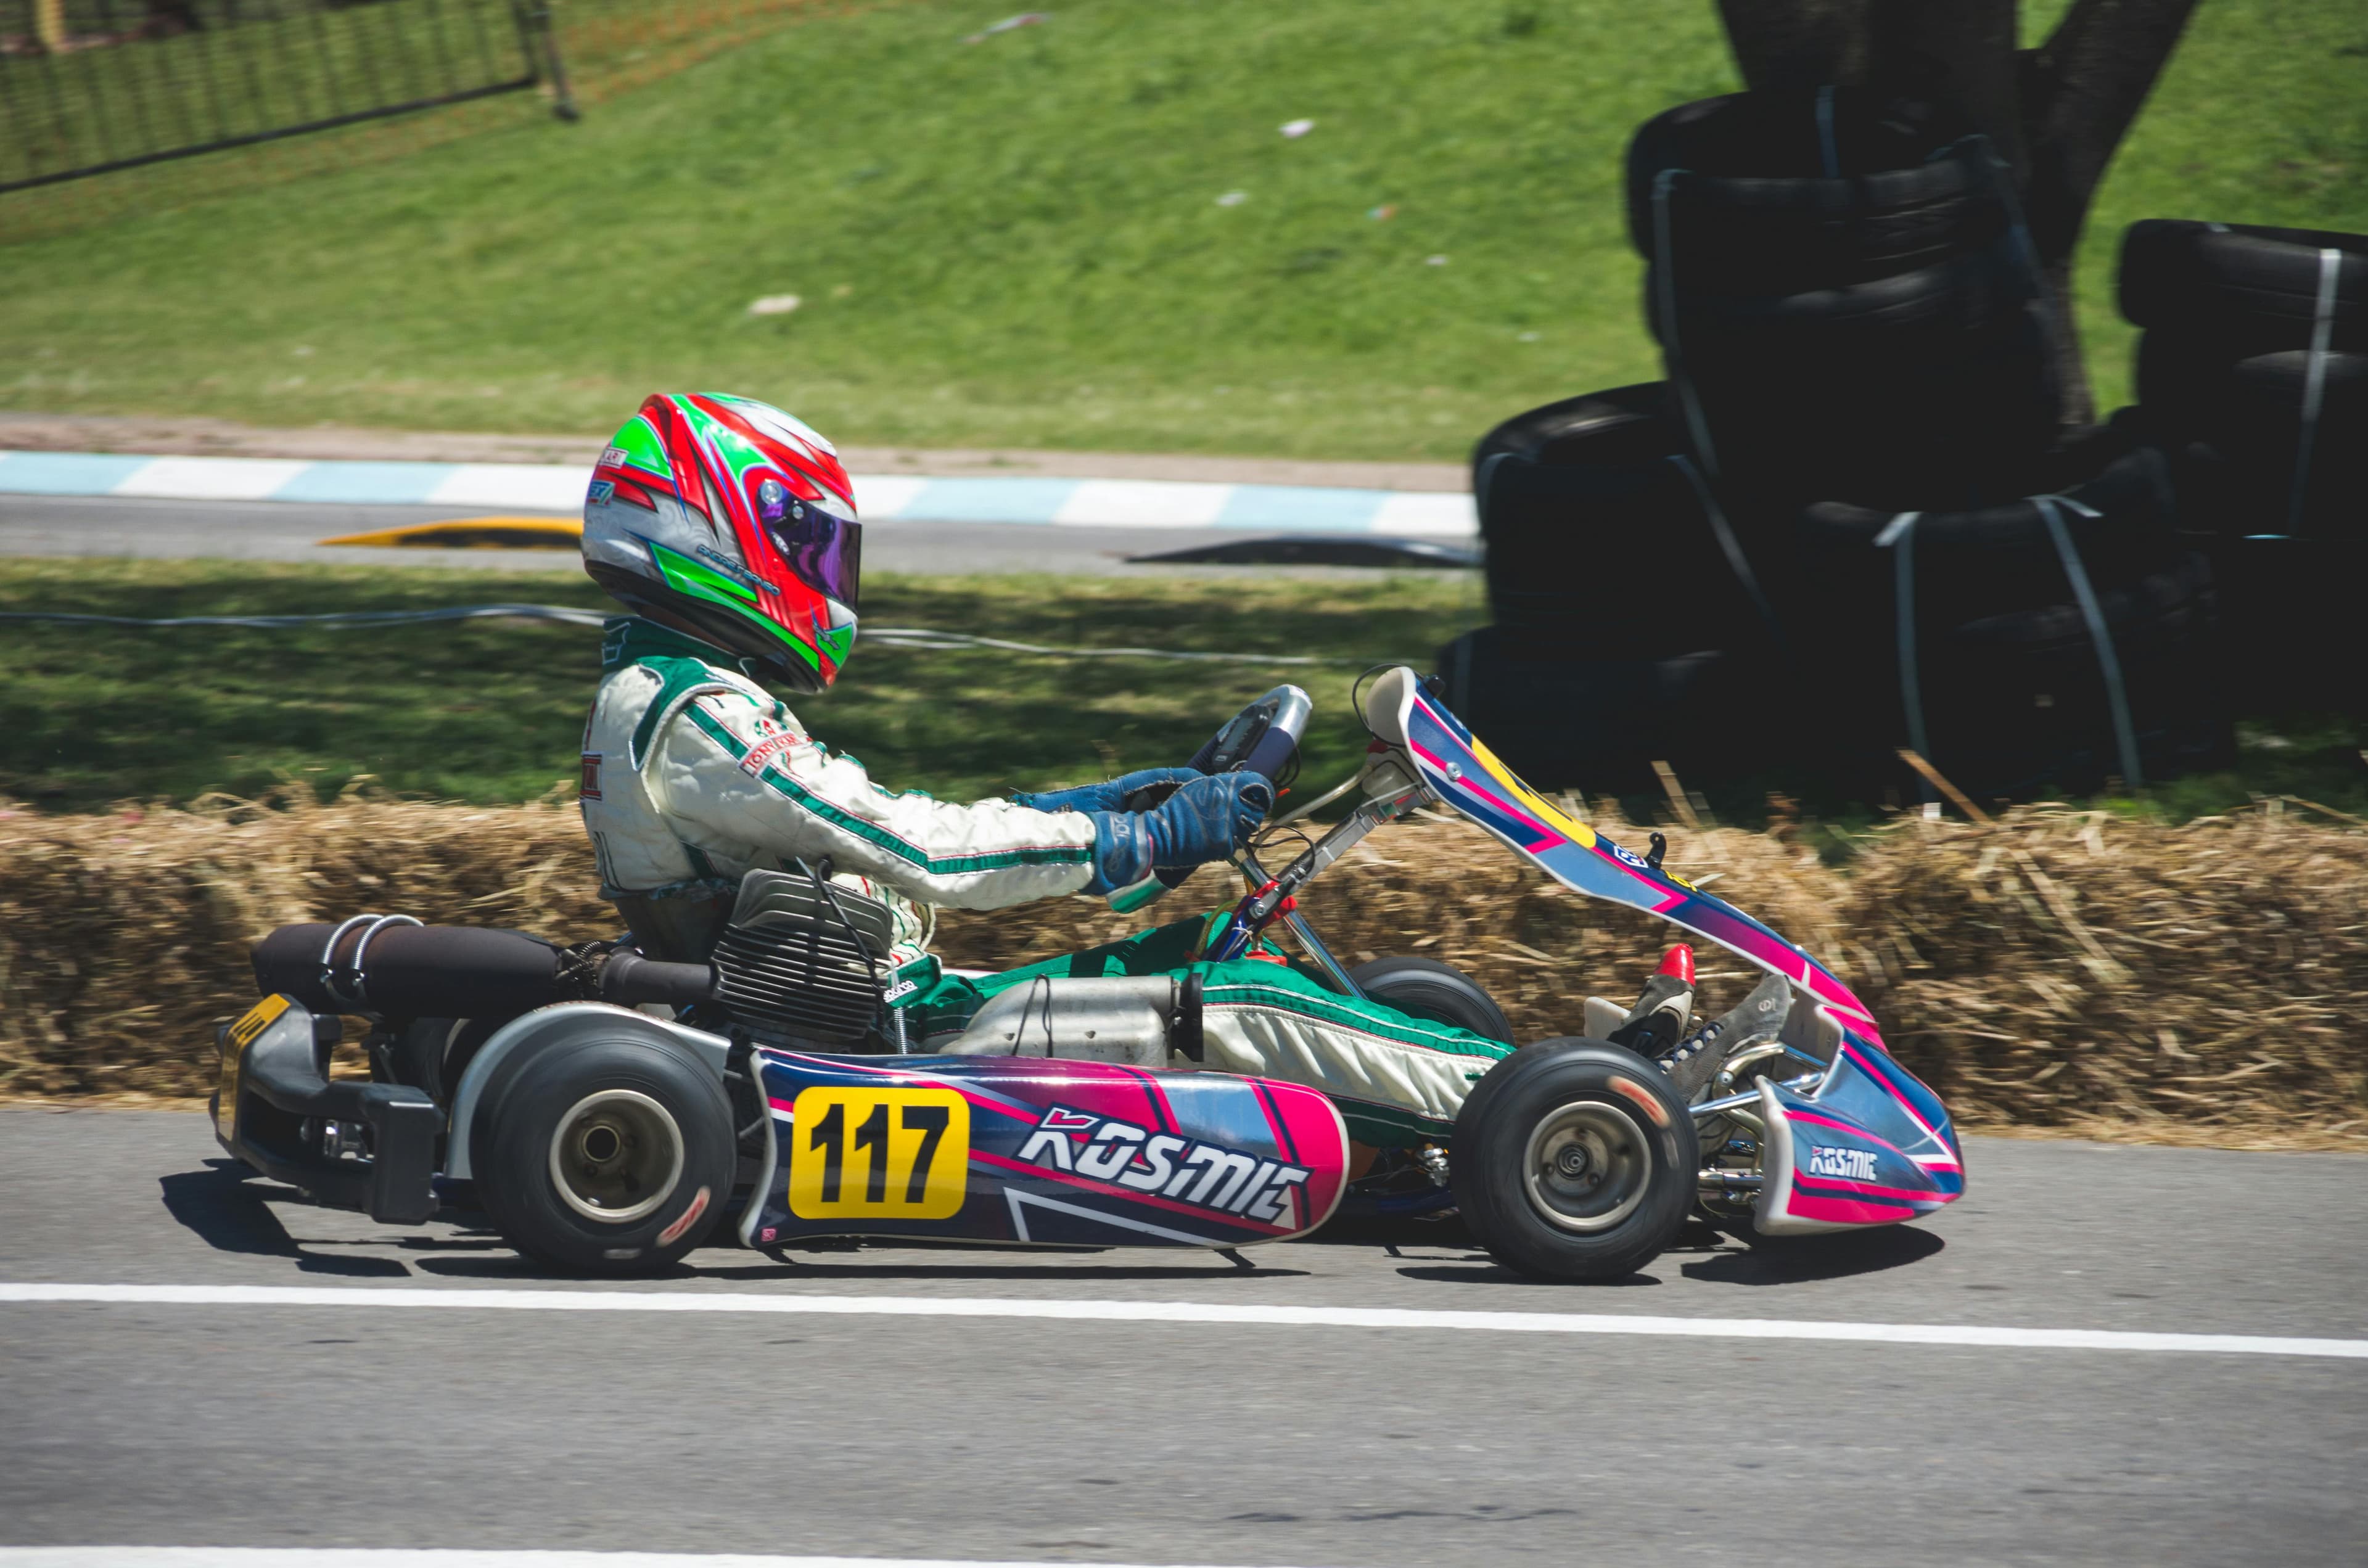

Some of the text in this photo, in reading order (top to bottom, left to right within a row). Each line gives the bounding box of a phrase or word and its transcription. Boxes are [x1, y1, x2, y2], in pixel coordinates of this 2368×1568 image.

[744, 741, 778, 771] TONY
[810, 1104, 949, 1203] 117
[1018, 1107, 1310, 1221] KOSMIC
[1809, 1146, 1877, 1180] KOSMIC
